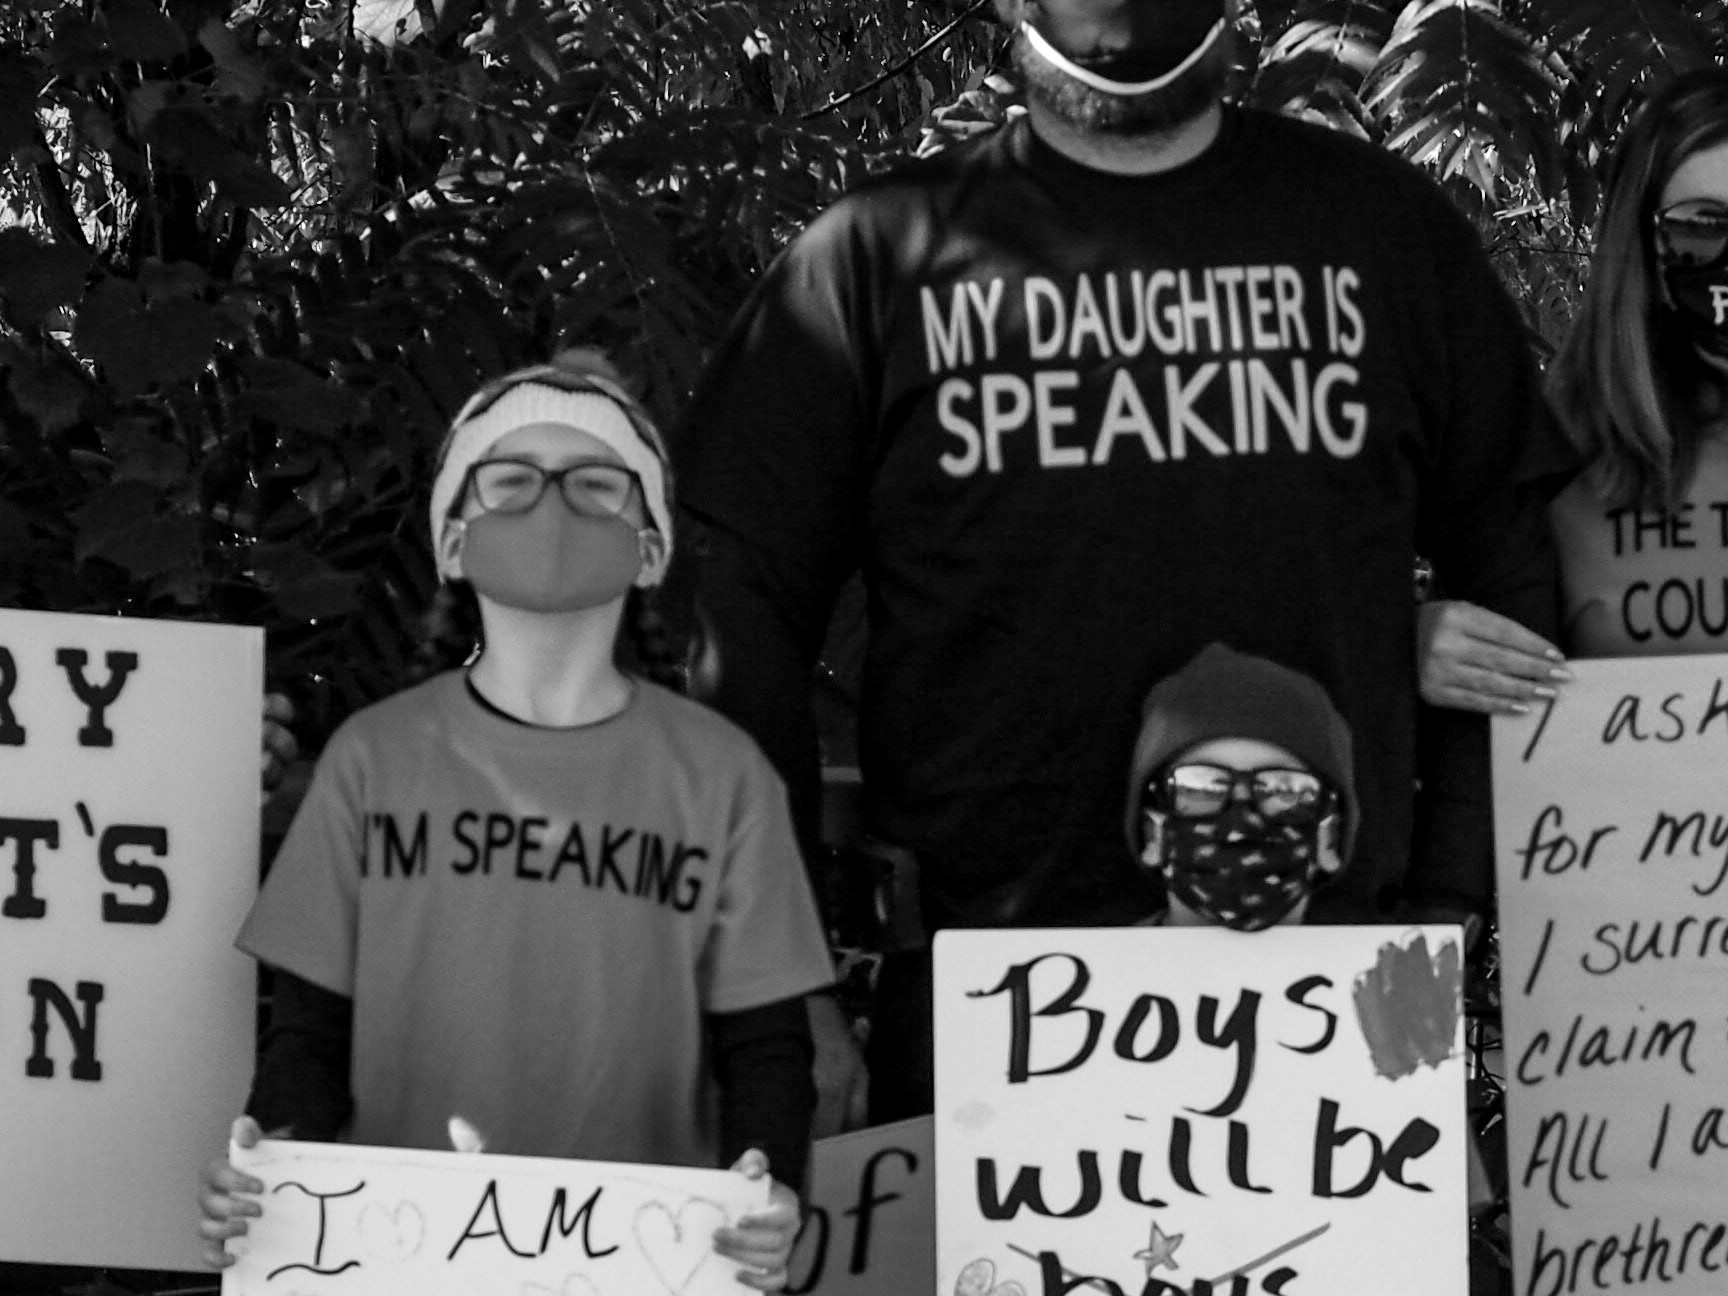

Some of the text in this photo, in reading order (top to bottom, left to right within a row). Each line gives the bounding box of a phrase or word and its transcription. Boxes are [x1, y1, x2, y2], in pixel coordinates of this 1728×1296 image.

[921, 264, 1364, 373] MY DAUGHTER IS
[937, 358, 1367, 478] SPEAKING
[1605, 503, 1697, 557] THE
[1522, 698, 1556, 763] I
[360, 810, 709, 913] I'M SPEAKING
[1515, 805, 1618, 880] for
[1523, 919, 1556, 996] I
[965, 952, 1338, 1117] Boys
[1516, 1005, 1698, 1085] claim
[976, 1096, 1441, 1221] will be
[1522, 1110, 1608, 1208] All
[1649, 1104, 1670, 1170] I
[266, 1179, 620, 1282] I AM
[779, 1147, 918, 1296] of
